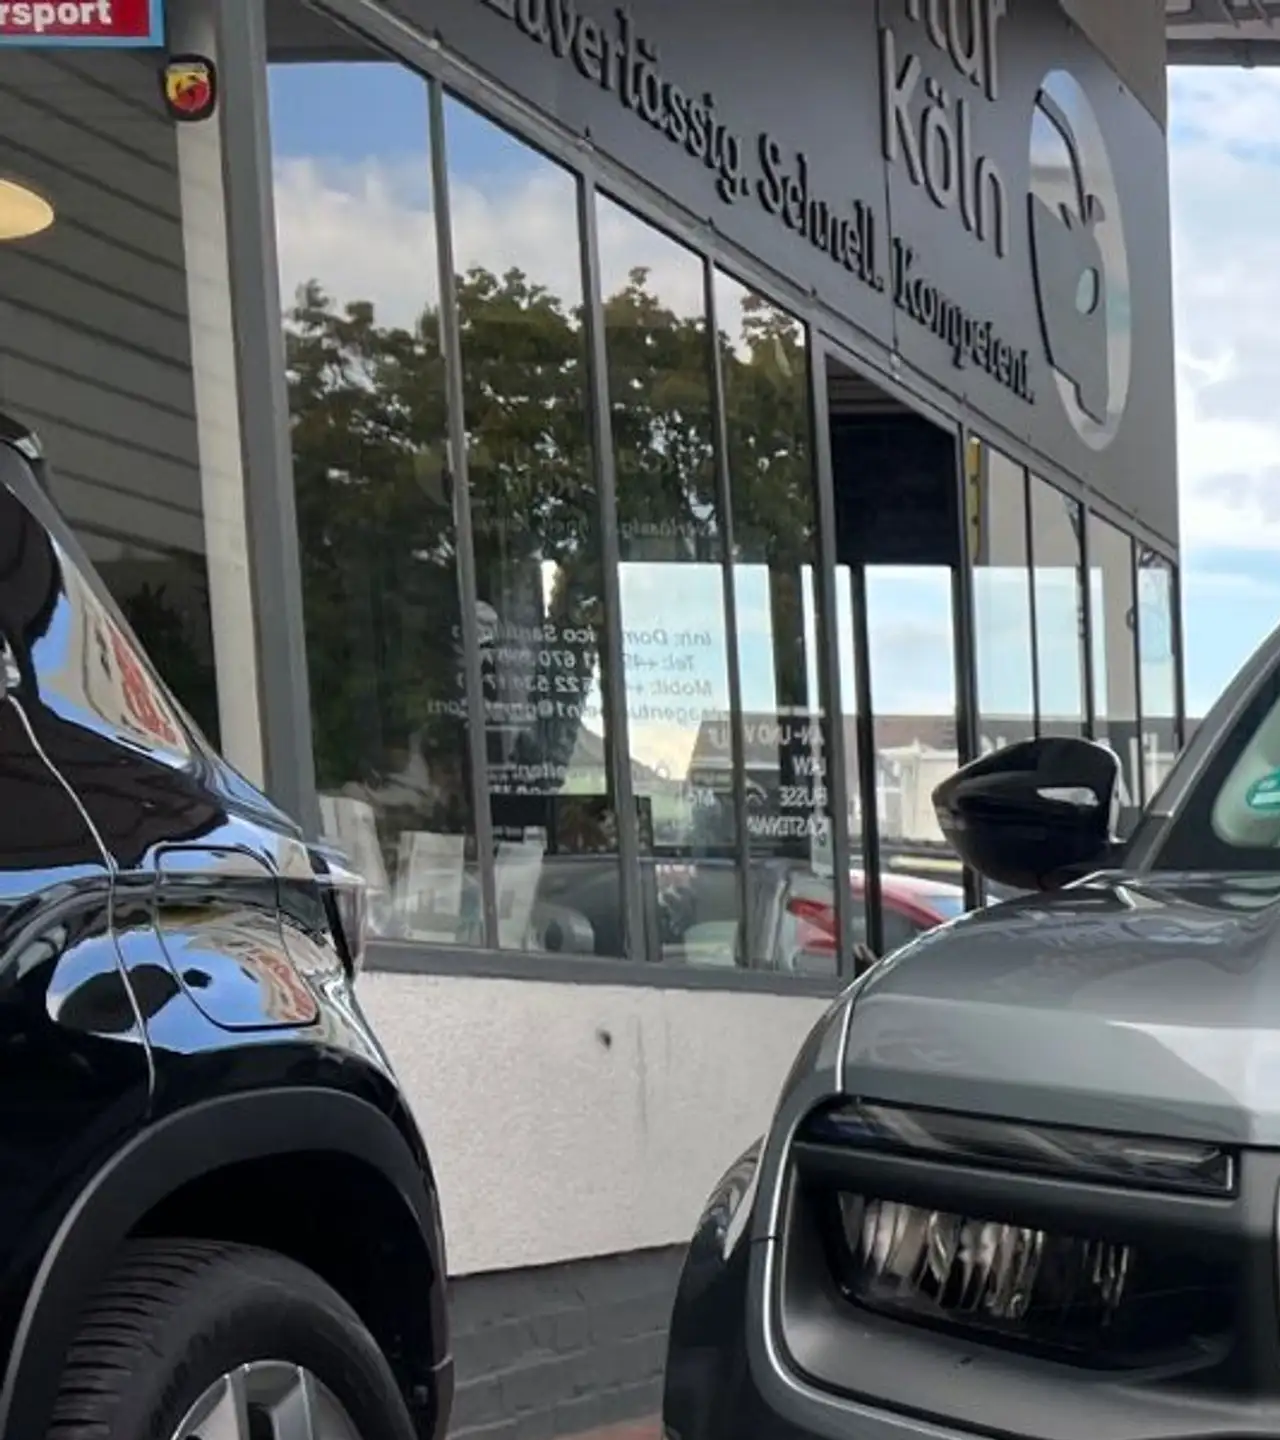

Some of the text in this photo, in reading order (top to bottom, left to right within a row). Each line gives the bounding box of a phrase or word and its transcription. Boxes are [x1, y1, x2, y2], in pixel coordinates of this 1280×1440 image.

[877, 27, 1009, 258] Köln
[757, 133, 885, 292] Schnell.
[892, 237, 1035, 405] Kompetent.
